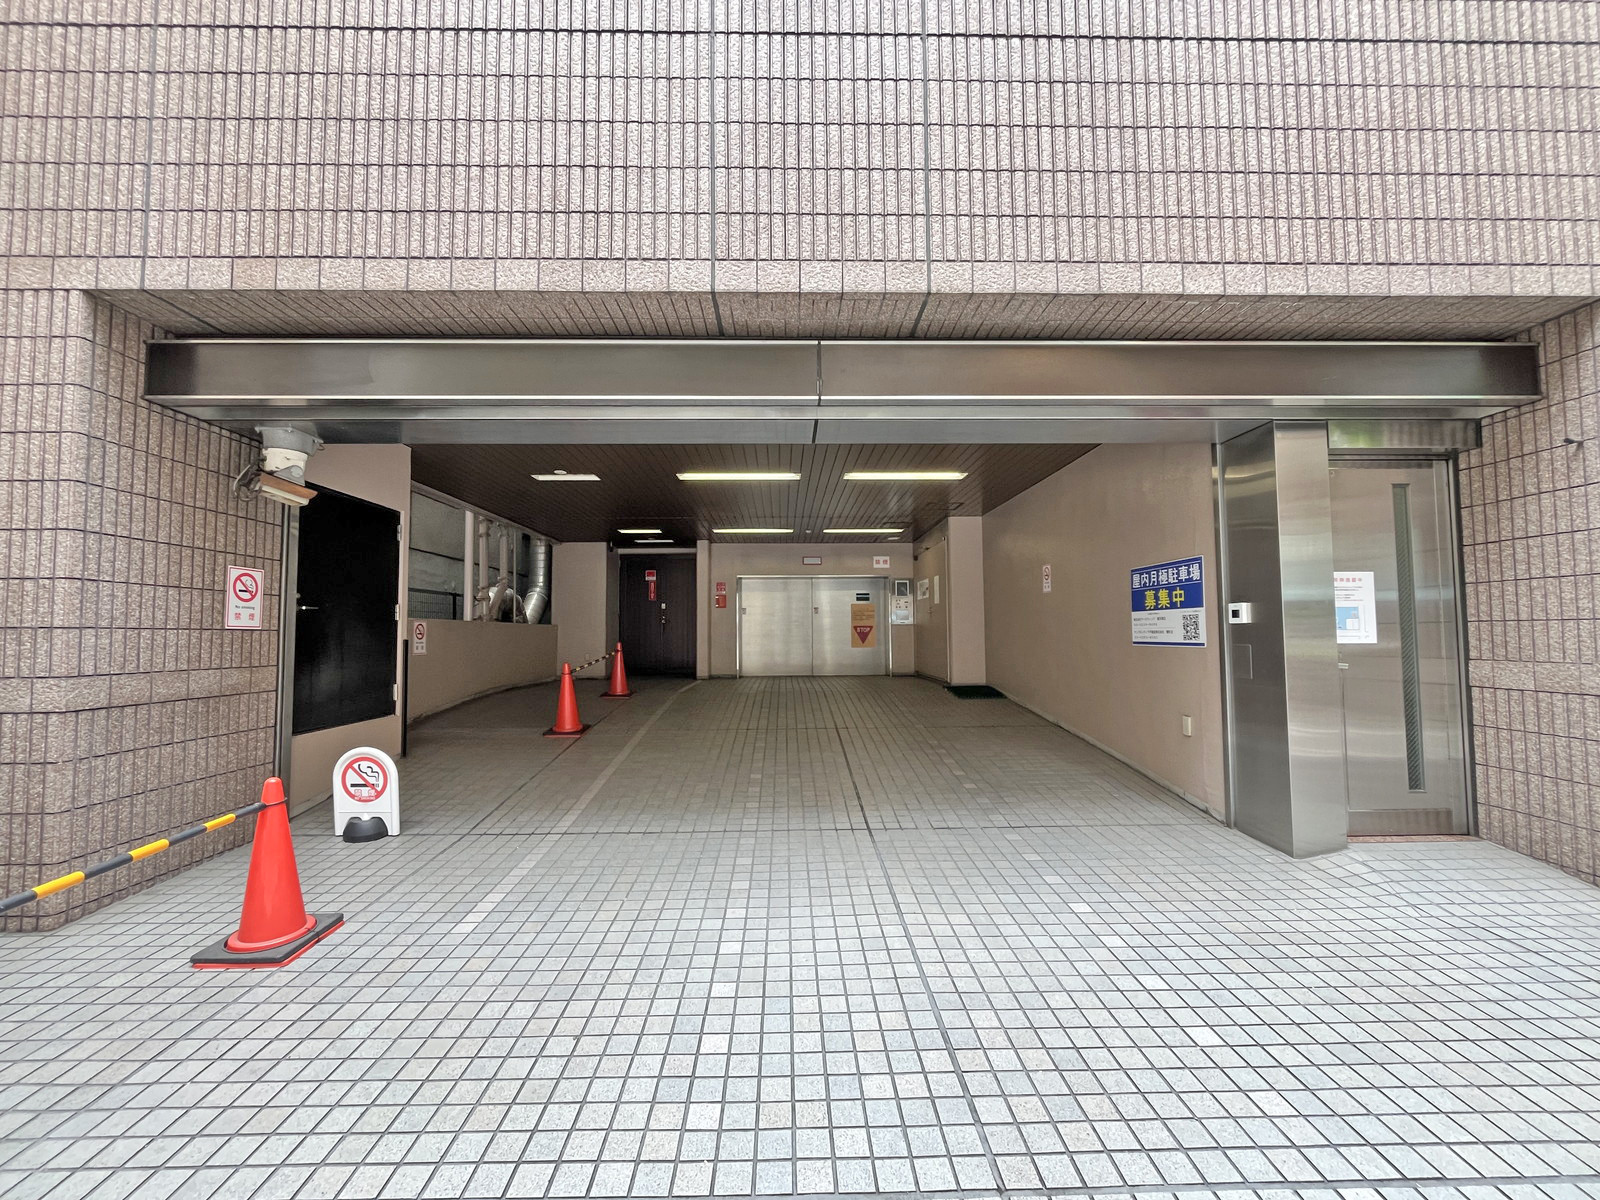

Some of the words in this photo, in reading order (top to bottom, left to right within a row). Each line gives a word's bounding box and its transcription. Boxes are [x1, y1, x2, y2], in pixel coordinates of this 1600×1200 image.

[1132, 564, 1200, 588] 屋内月極駐車場
[1145, 587, 1184, 609] 募集中
